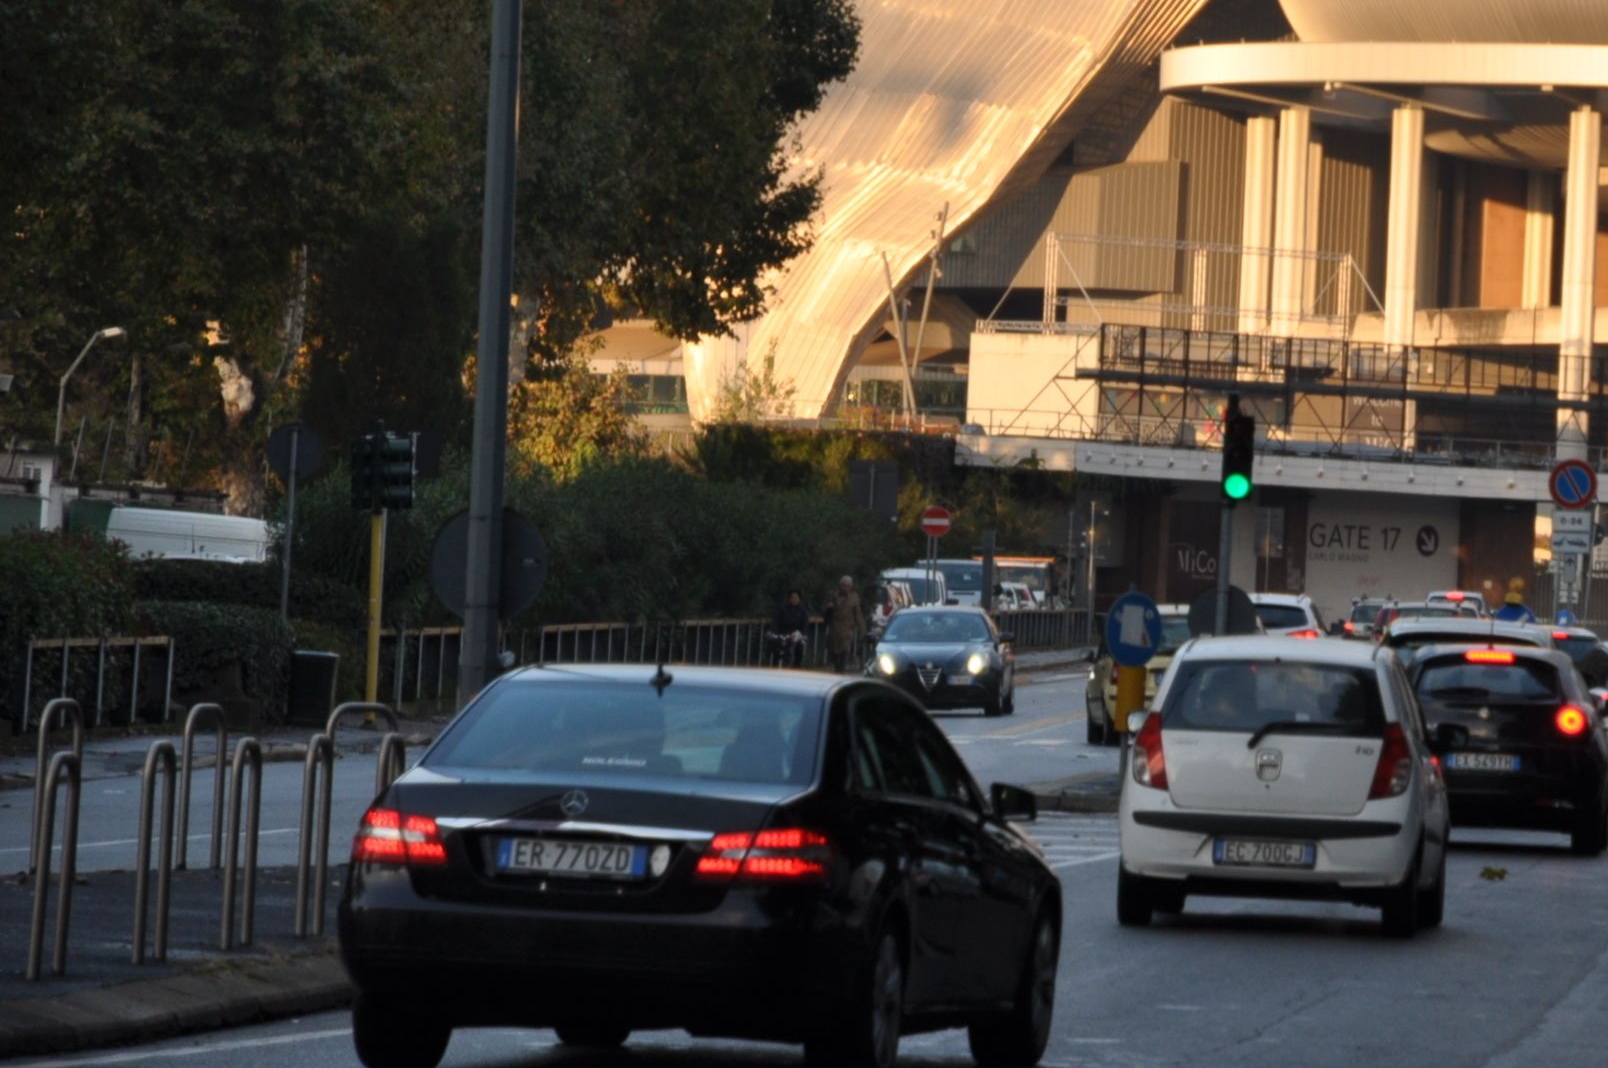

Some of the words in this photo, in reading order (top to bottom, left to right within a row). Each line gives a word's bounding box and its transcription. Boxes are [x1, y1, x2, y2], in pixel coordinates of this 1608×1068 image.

[1309, 523, 1371, 550] GATE
[1381, 526, 1402, 551] 17
[1177, 549, 1217, 573] MiCo
[514, 840, 545, 867] ER
[552, 843, 631, 873] 770ZD
[1226, 841, 1246, 860] EC
